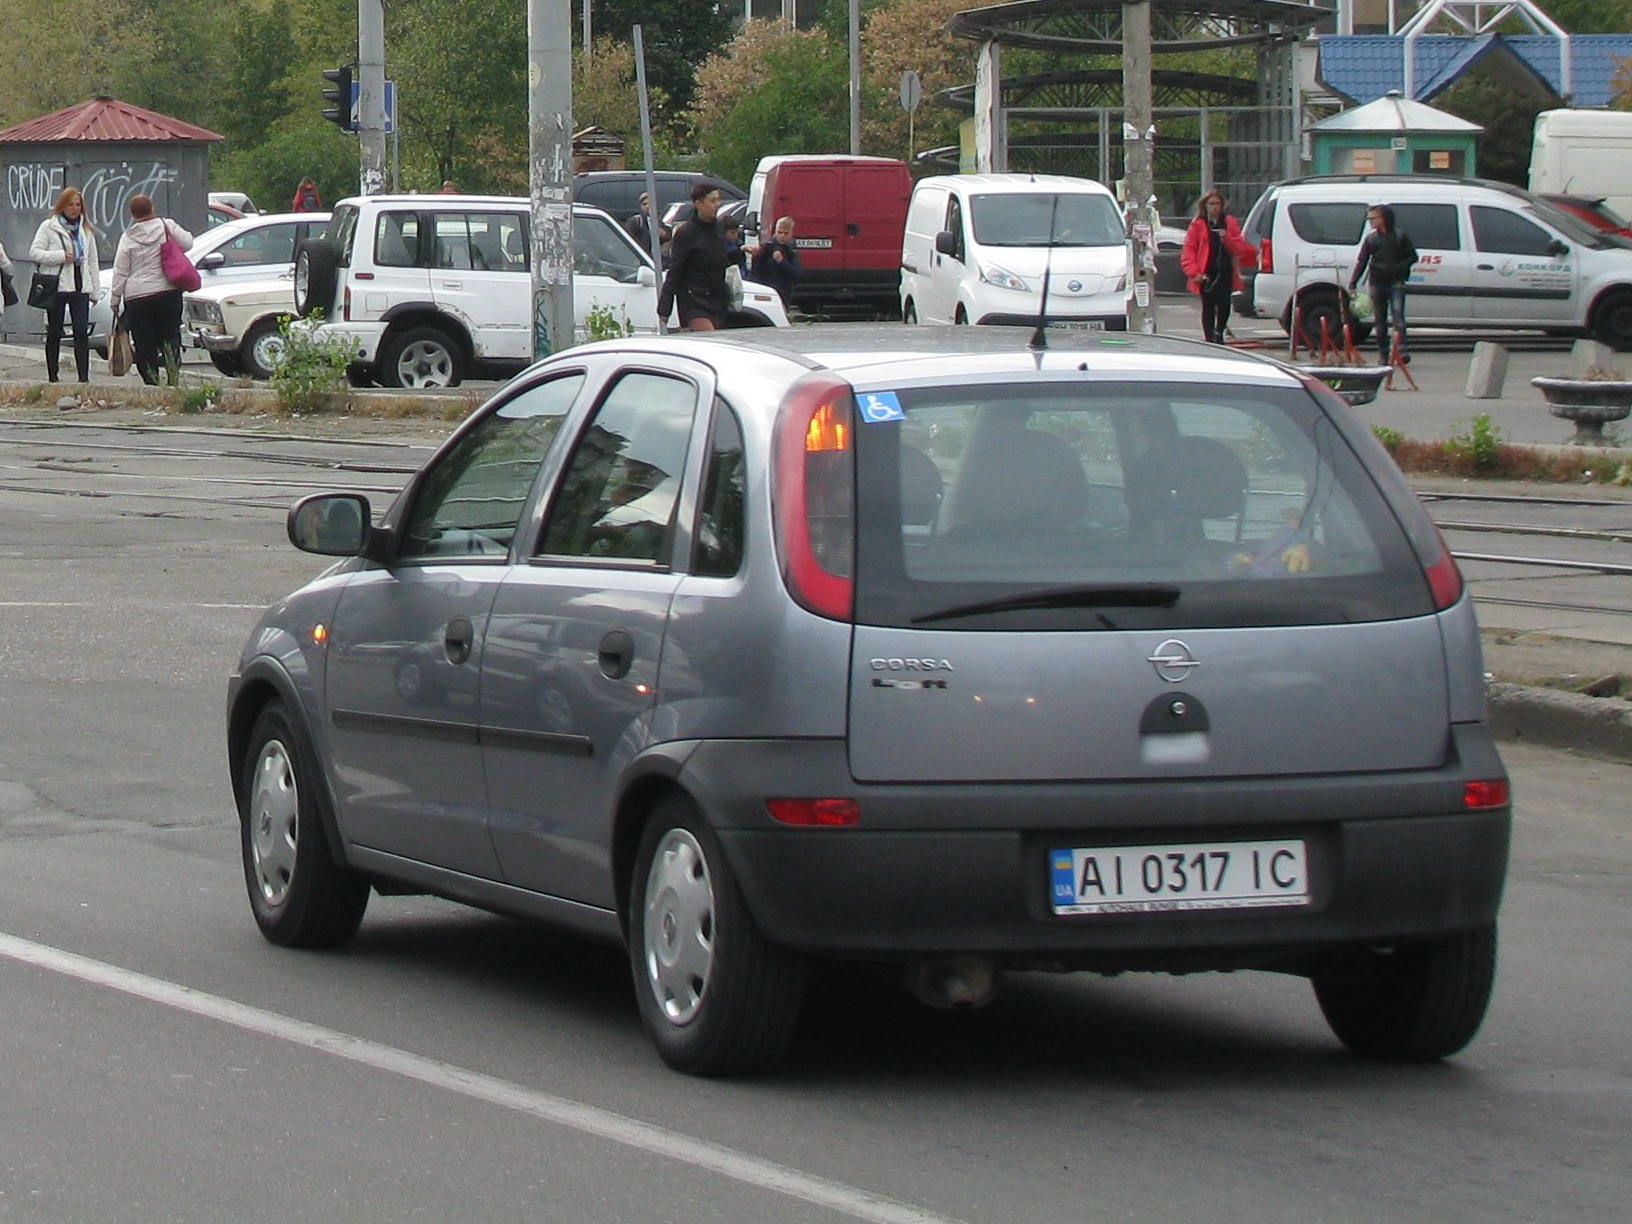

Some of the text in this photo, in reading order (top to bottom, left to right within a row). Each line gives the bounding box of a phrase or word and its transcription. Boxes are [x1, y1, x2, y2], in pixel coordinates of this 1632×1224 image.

[870, 657, 953, 672] CORSA
[1079, 849, 1297, 897] AI 0317 IC
[1055, 885, 1074, 897] UA
